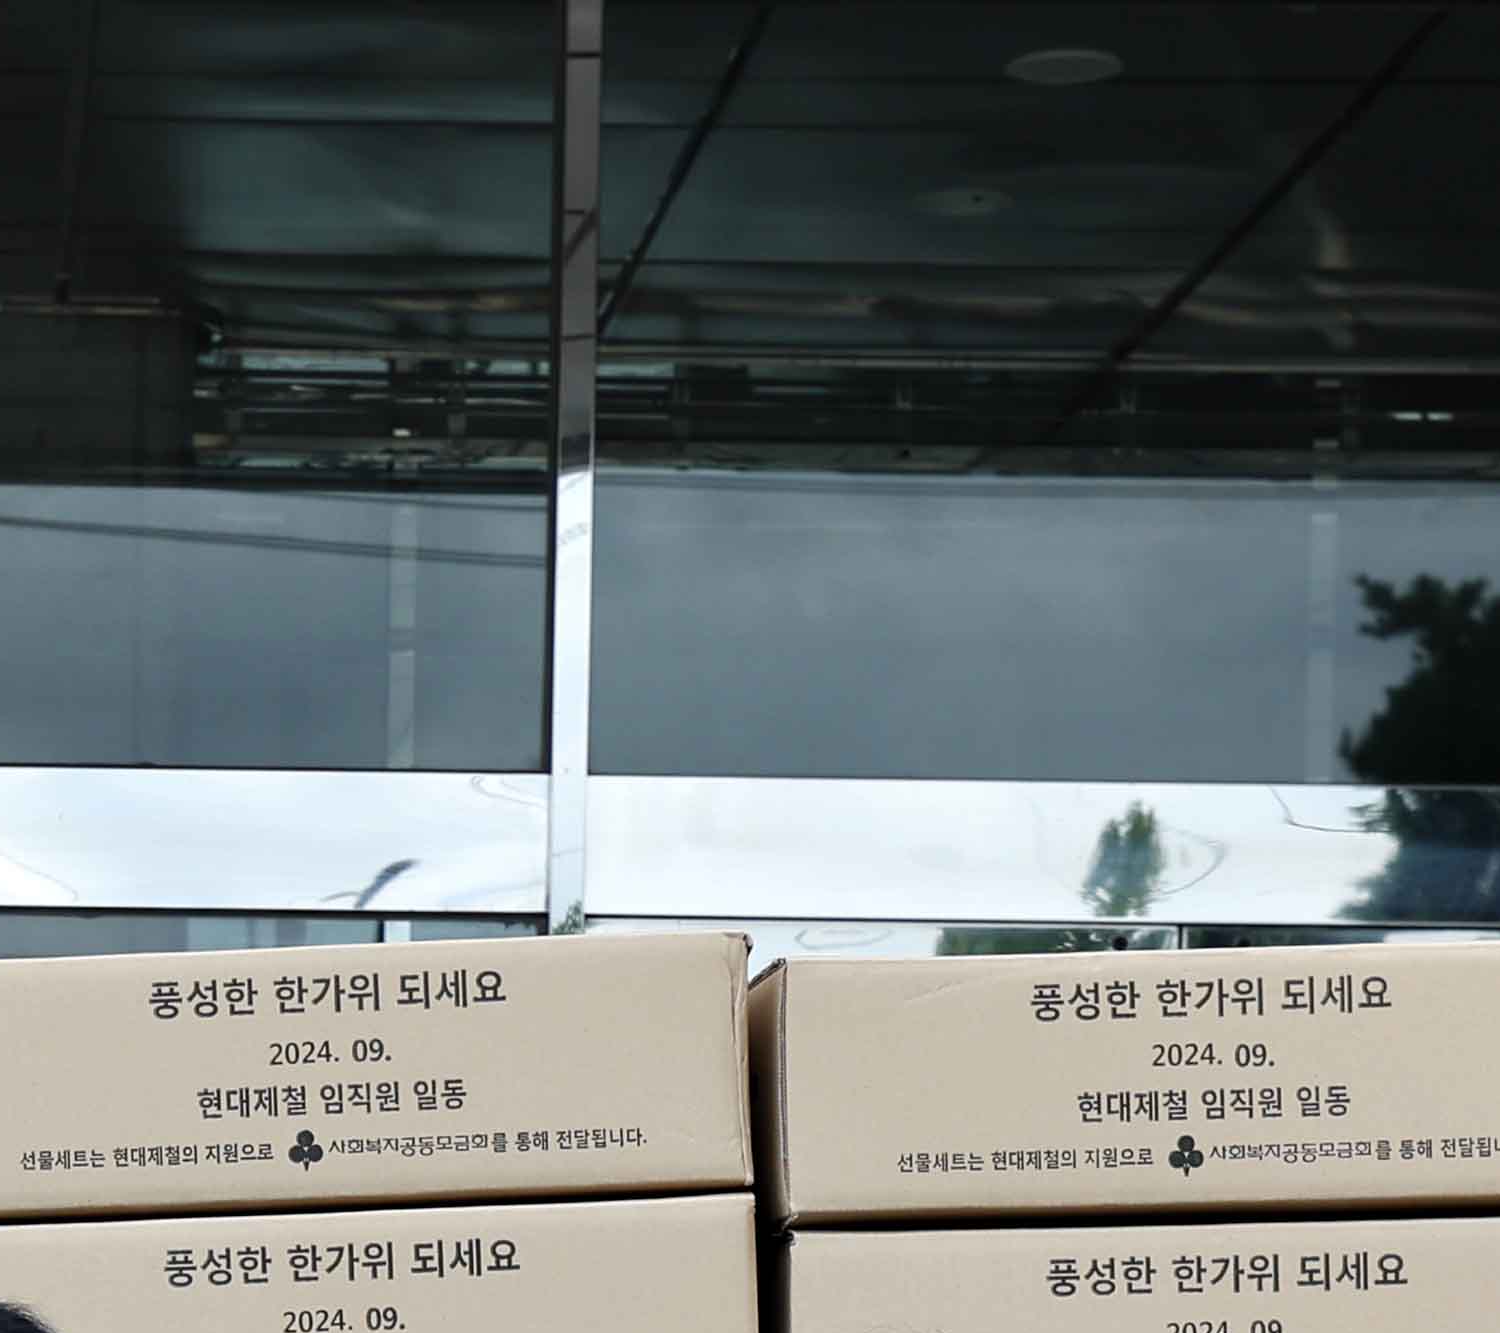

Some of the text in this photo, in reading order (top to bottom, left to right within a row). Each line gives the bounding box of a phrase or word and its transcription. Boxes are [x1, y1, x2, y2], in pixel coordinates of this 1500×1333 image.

[148, 968, 507, 1020] 풍성한 한가위 되세요
[1030, 974, 1393, 1022] 풍성한 한가위 되세요
[269, 1037, 392, 1066] 2024. 09.
[1151, 1042, 1275, 1068] 2024. 09.
[196, 1078, 467, 1120] 현대제철 임직원 일동
[1077, 1085, 1351, 1123] 현대제철 임직원 일동
[20, 1149, 106, 1171] 선물세트는
[112, 1144, 198, 1168] 현대제철의
[204, 1143, 274, 1165] 지원으로
[514, 1130, 549, 1152] 통해
[556, 1127, 648, 1150] 전달됩니다.
[897, 1151, 985, 1173] 선물세트는
[991, 1149, 1077, 1171] 현대제철의
[1084, 1147, 1154, 1169] 지원으로
[1398, 1138, 1433, 1160] 통해
